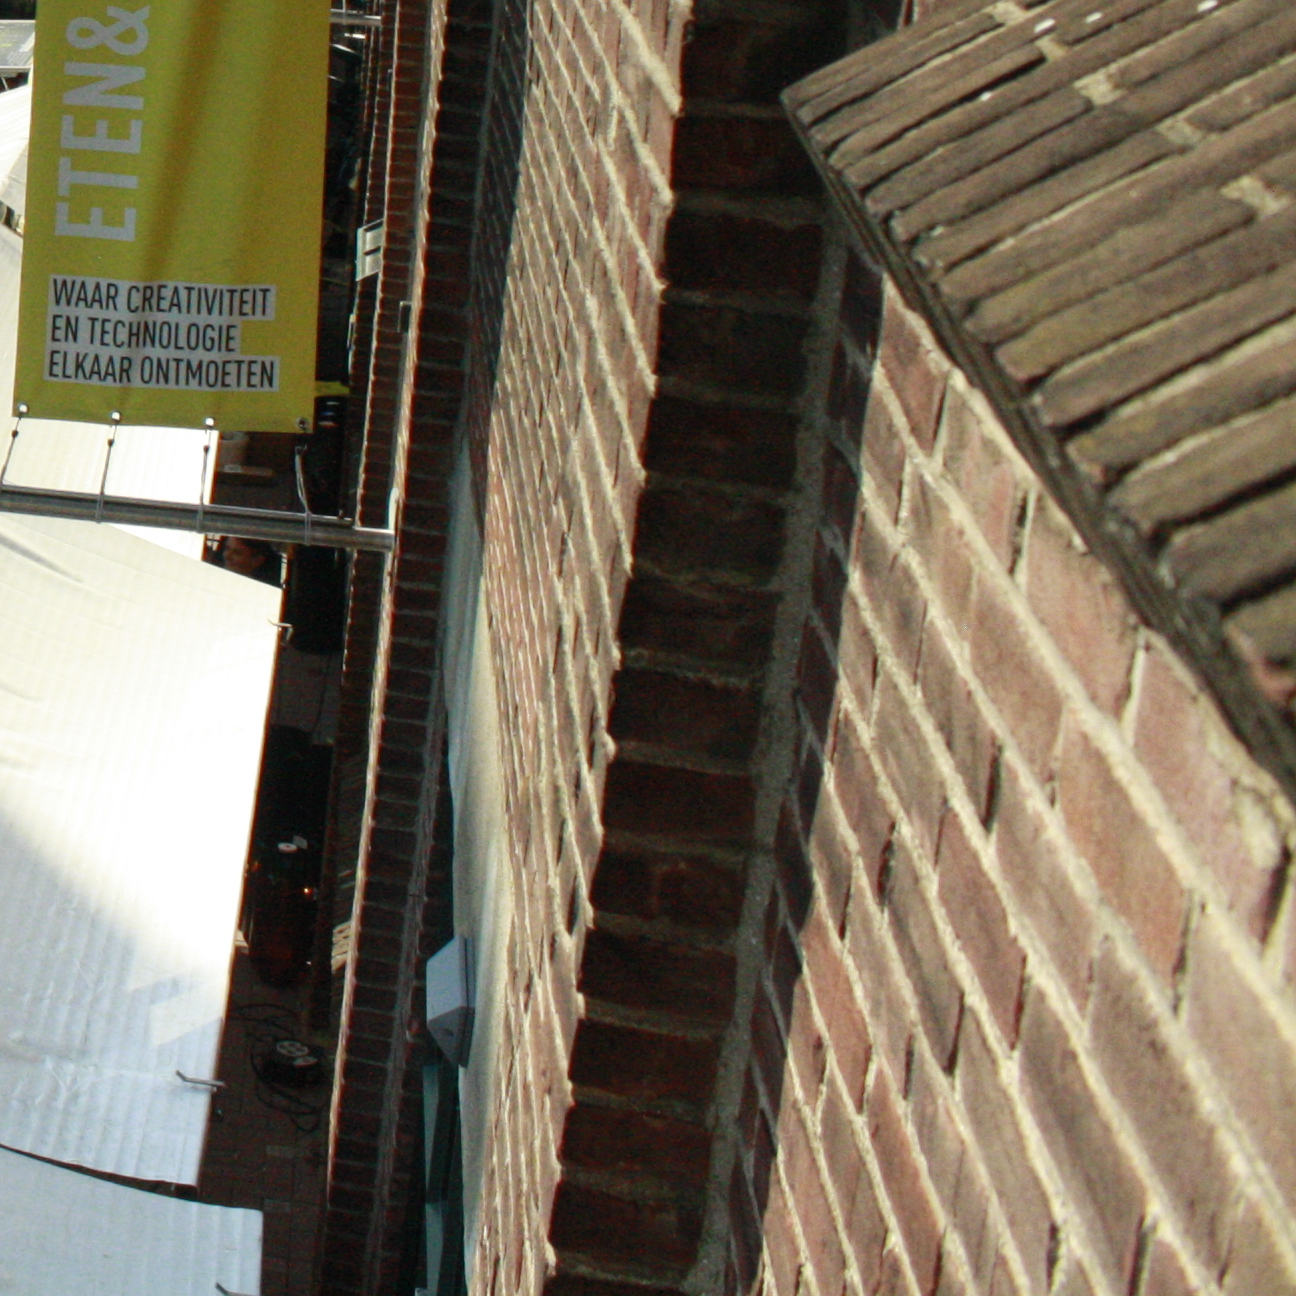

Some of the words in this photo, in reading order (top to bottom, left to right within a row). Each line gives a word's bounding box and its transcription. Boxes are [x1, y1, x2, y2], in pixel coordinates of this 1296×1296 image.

[52, 278, 119, 311] WAAR
[126, 284, 272, 317] CREATIVITEIT
[51, 314, 79, 343] EN
[88, 317, 238, 353] TECHNOLOGIE
[48, 350, 133, 384] ELKAAR
[140, 356, 275, 389] ONTMOETEN
